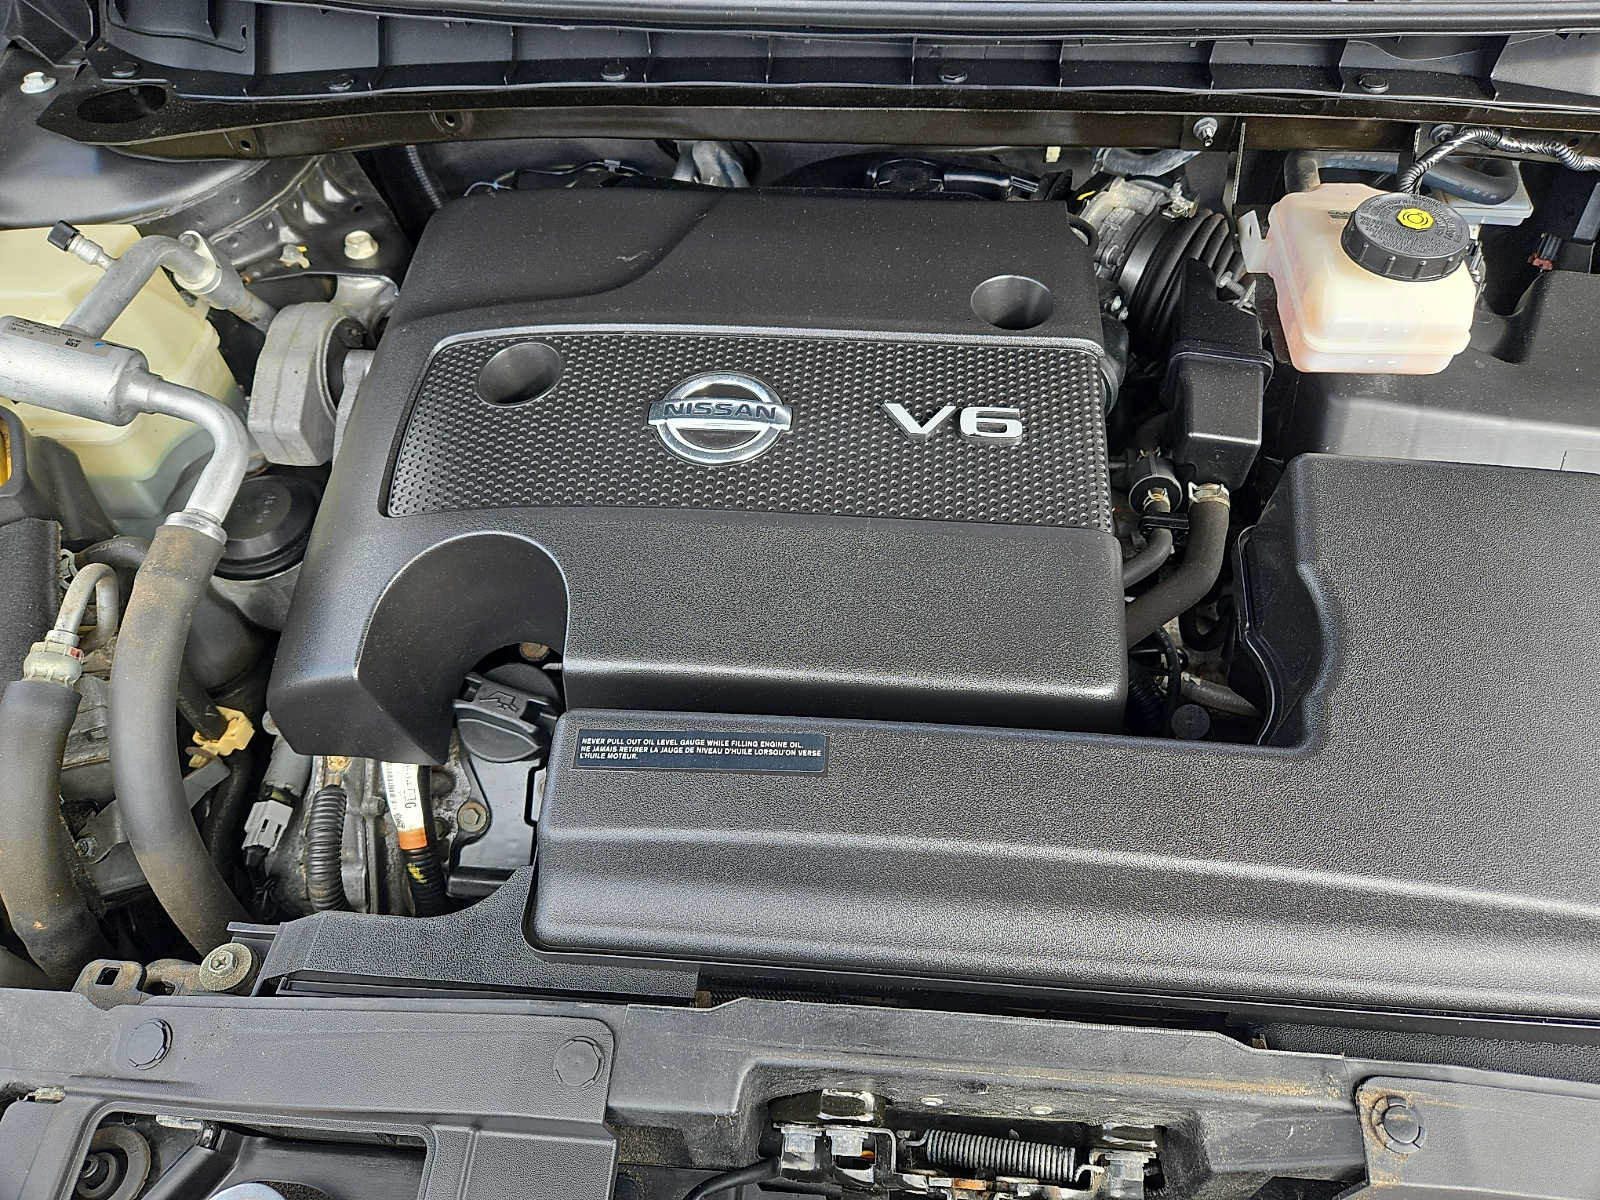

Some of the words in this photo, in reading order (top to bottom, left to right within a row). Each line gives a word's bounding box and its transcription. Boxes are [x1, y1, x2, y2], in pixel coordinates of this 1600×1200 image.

[663, 401, 778, 421] NISSAN
[882, 402, 1023, 443] V6
[581, 737, 605, 745] NEVER
[643, 738, 655, 746] OIL
[680, 739, 705, 747] GAUGE
[706, 739, 729, 747] WHILE
[731, 740, 758, 748] FILLING
[760, 740, 788, 748] ENGINE
[789, 741, 804, 749] OIL.
[591, 745, 617, 753] JAMAIS
[660, 746, 683, 754] JAUGE
[696, 747, 723, 755] NIVEAU
[724, 747, 753, 755] D'HUILE
[754, 748, 796, 756] LORSQU'ON
[798, 749, 822, 757] VERSE
